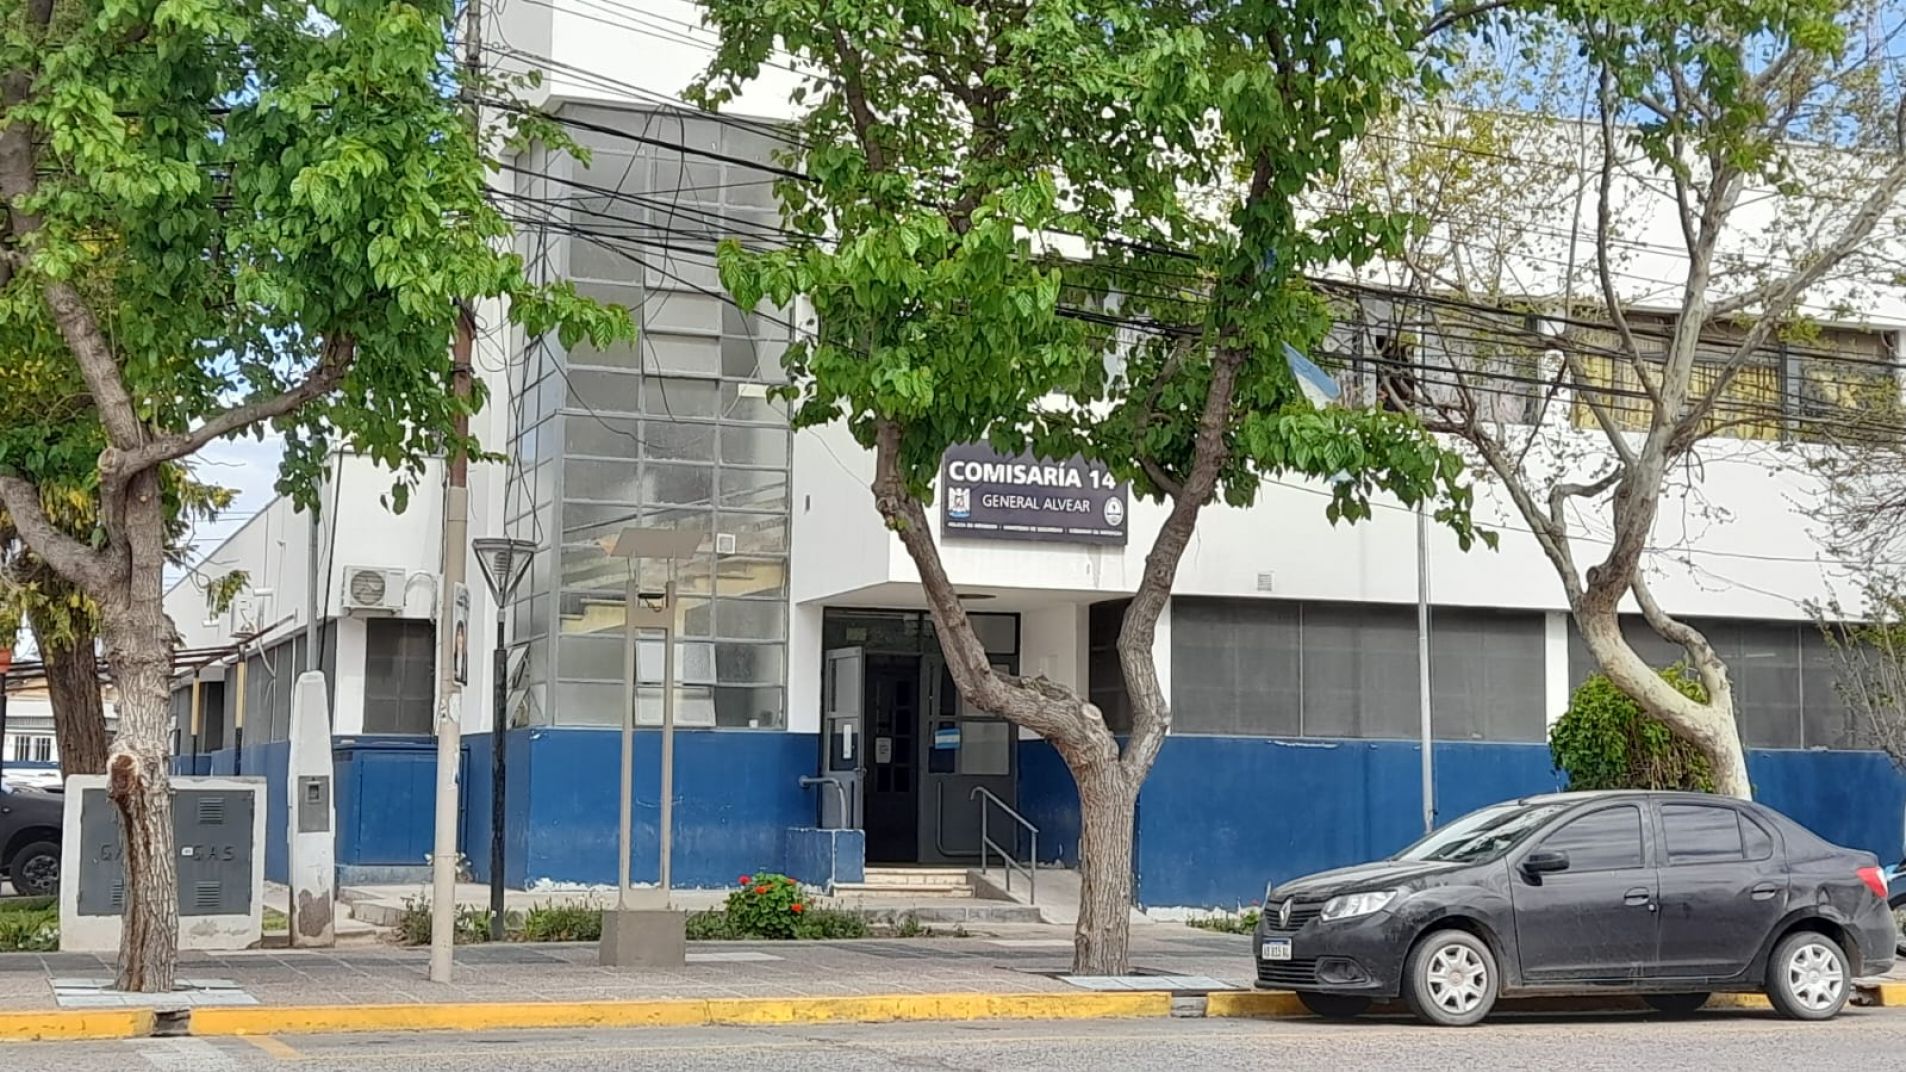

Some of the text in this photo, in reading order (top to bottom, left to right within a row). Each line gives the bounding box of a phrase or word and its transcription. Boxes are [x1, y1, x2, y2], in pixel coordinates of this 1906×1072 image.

[949, 460, 1116, 490] COMISARÍA 14
[982, 494, 1091, 513] GENERAL ALVEAR
[193, 844, 236, 862] GAS
